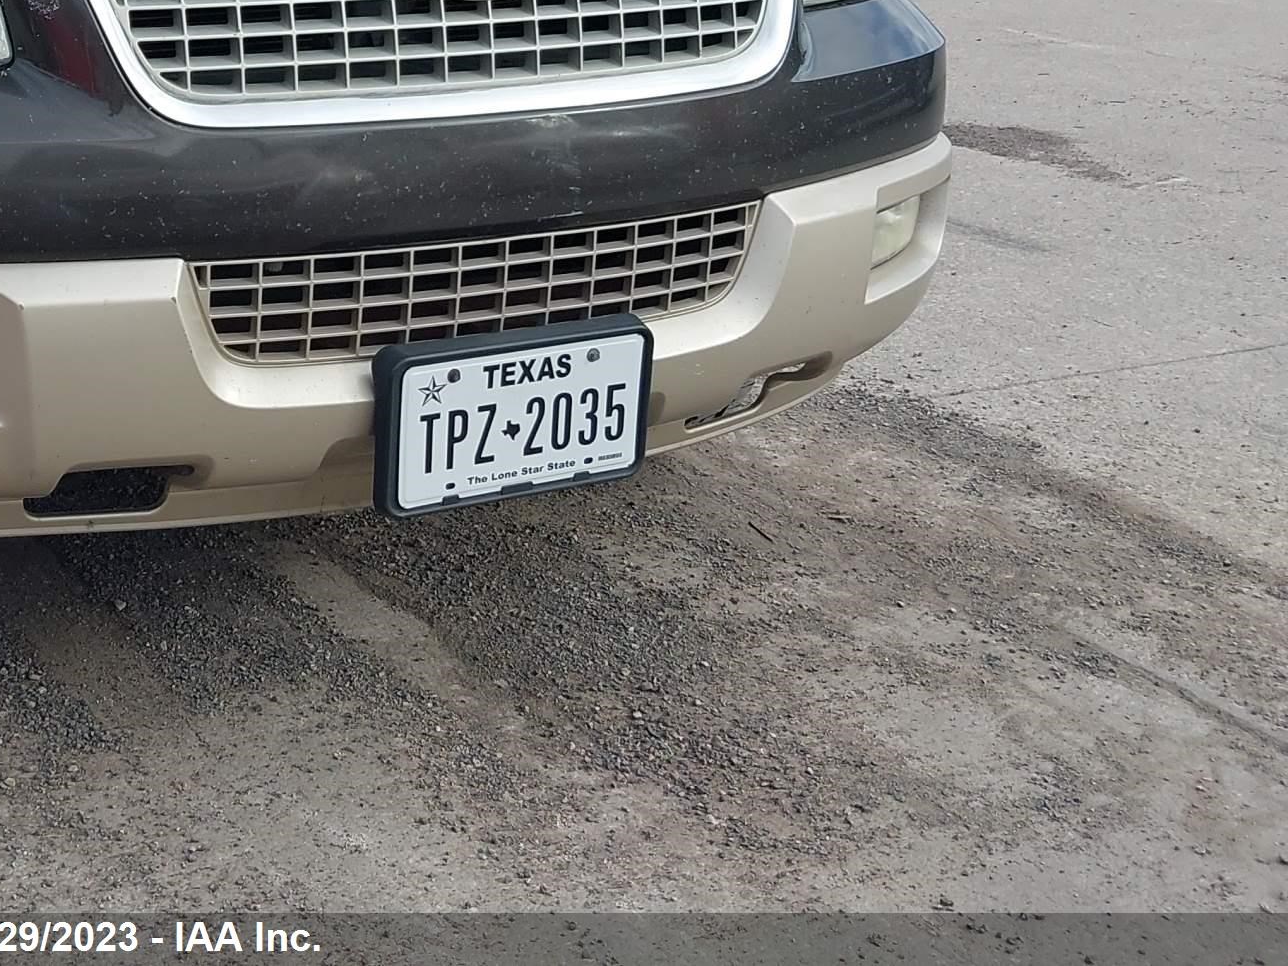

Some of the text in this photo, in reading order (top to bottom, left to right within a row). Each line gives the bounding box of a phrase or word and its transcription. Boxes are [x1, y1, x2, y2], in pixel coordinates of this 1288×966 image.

[483, 353, 572, 389] TEXAS
[419, 383, 626, 474] TPZ 2035
[467, 459, 576, 485] The Lone Star State
